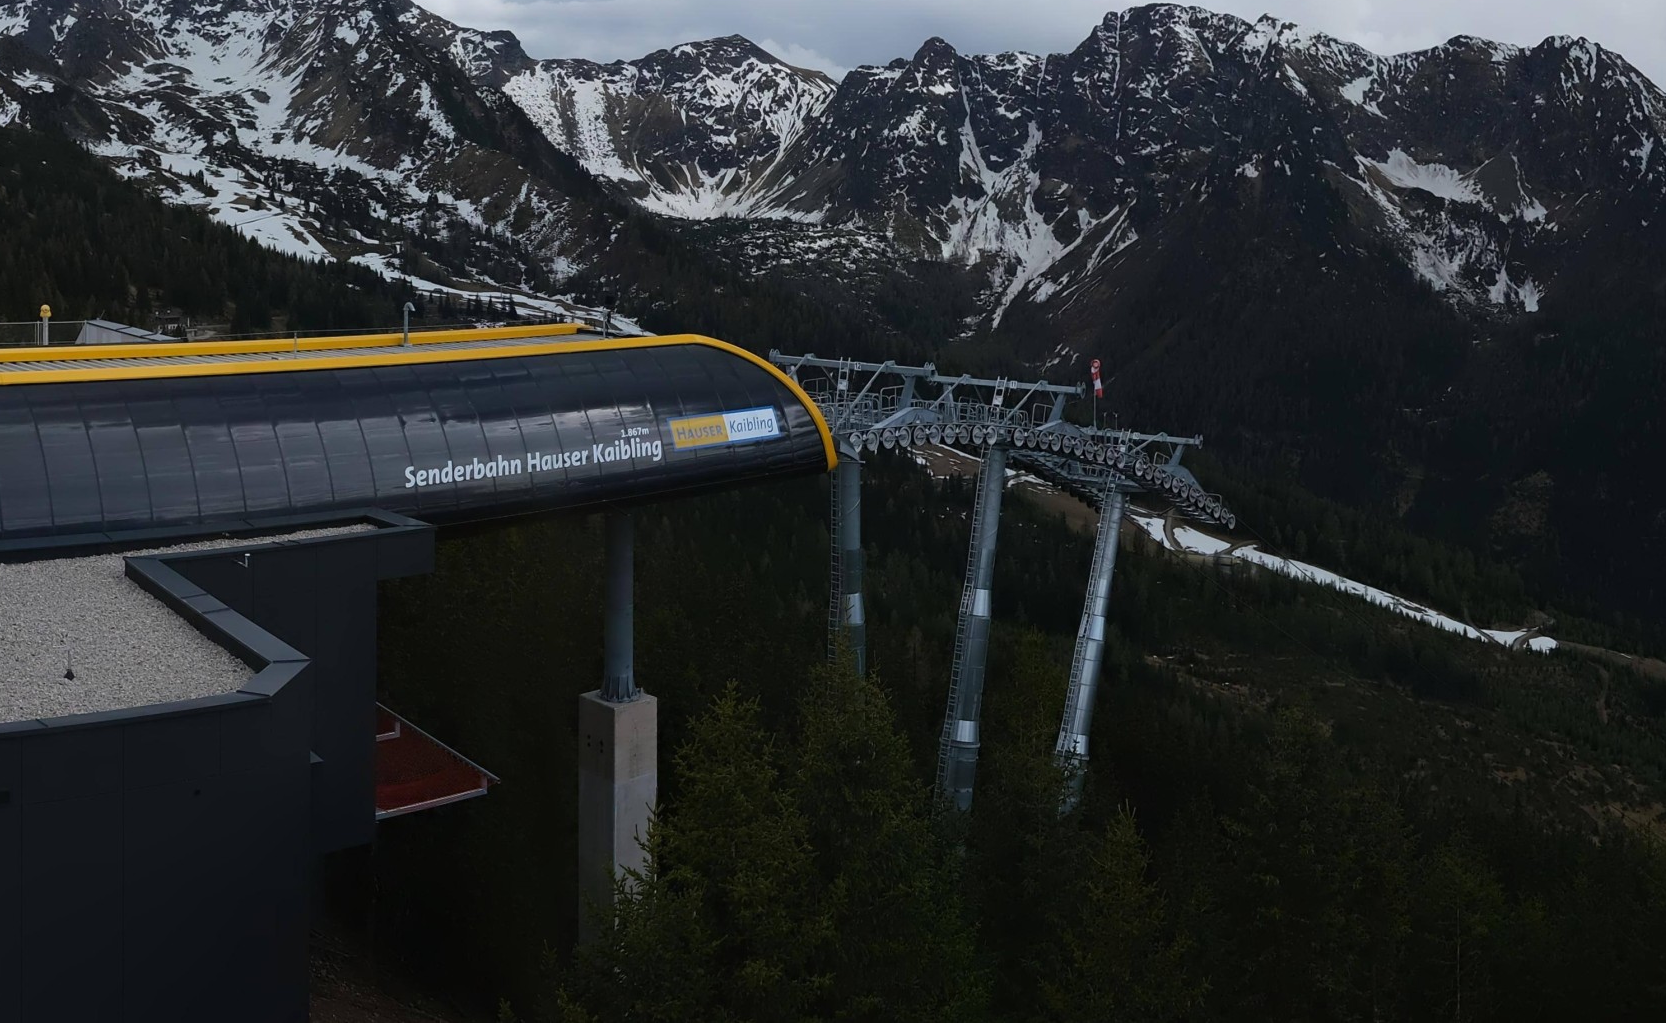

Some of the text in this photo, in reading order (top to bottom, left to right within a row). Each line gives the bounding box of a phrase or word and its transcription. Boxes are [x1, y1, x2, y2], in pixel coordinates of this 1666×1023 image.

[620, 426, 650, 438] 1.867m
[676, 417, 774, 440] HAUSER Kaibling
[404, 438, 663, 489] Senderbahn Hauser Kaibling
